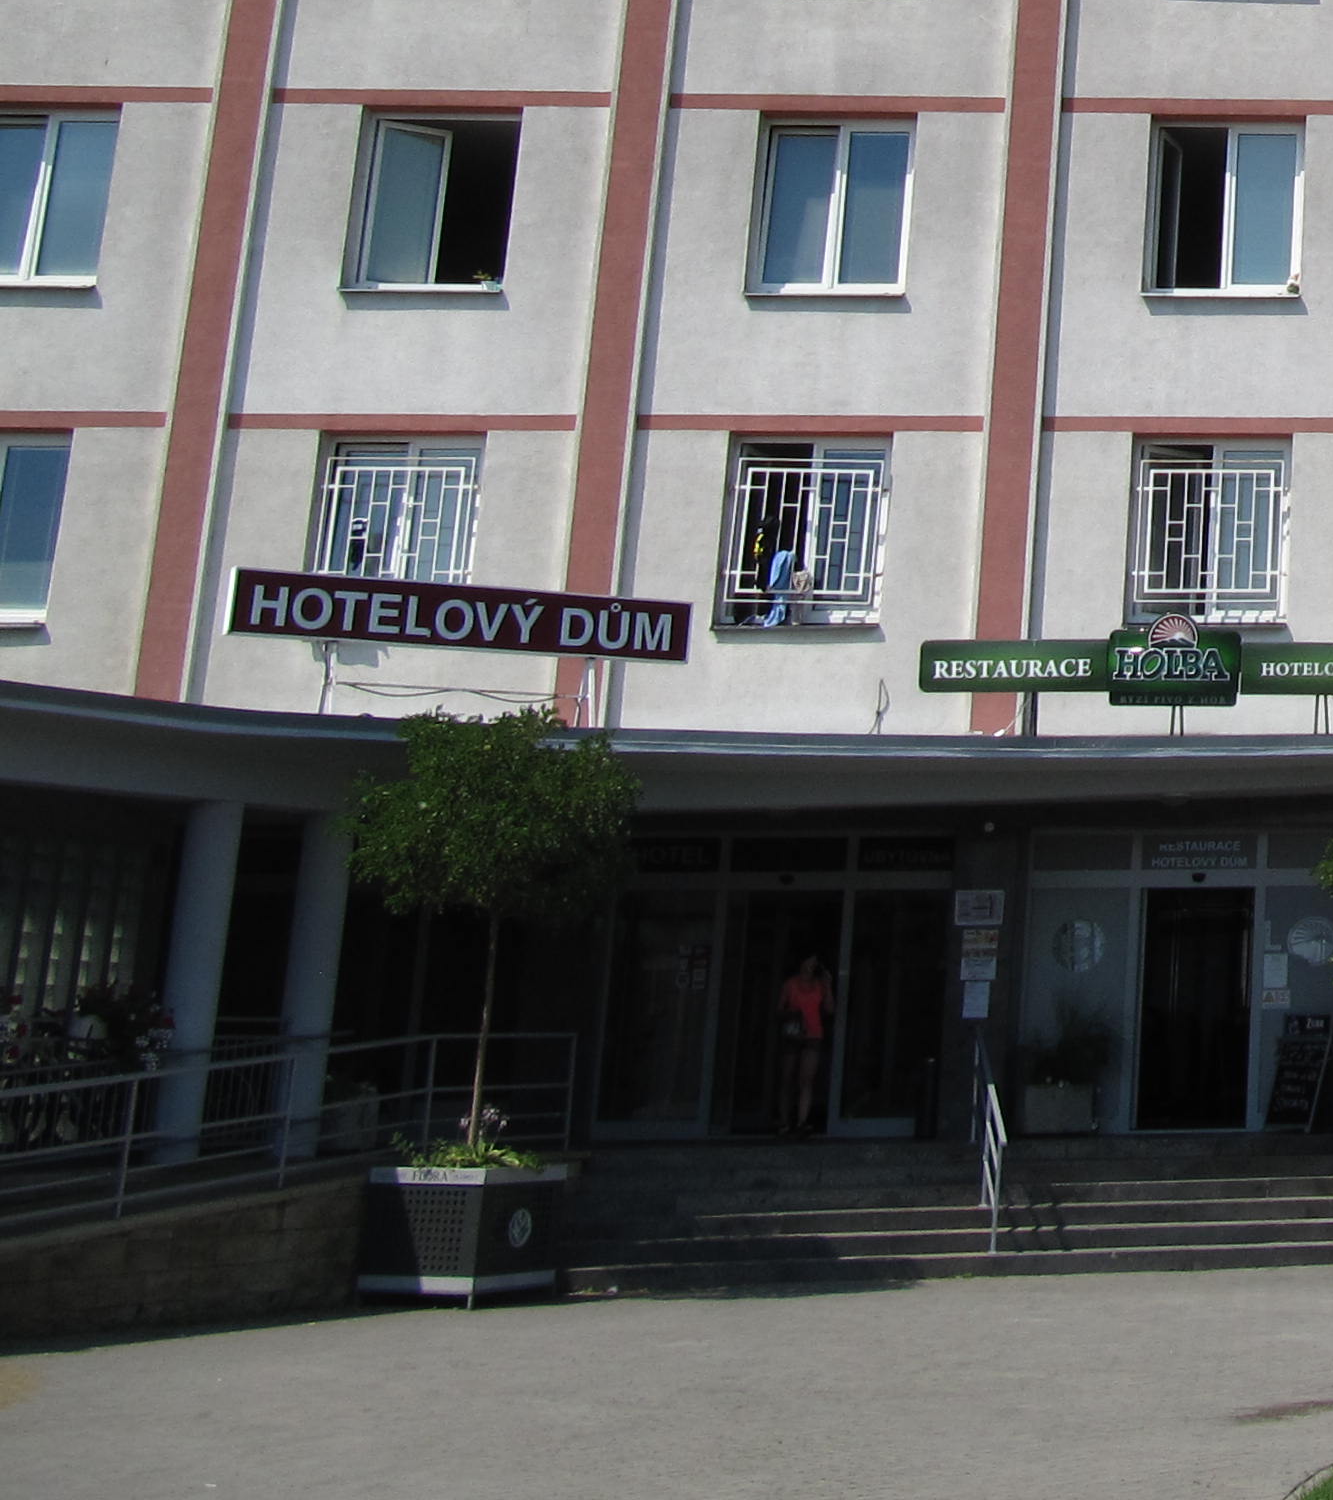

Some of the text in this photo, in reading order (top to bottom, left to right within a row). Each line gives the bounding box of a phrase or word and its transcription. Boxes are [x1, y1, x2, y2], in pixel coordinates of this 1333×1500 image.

[248, 584, 673, 652] HOTELOVÝ DŮM
[932, 658, 1092, 680] RESTAURACE
[1113, 647, 1231, 681] HOLBA
[1158, 840, 1241, 853] RESTAURACE
